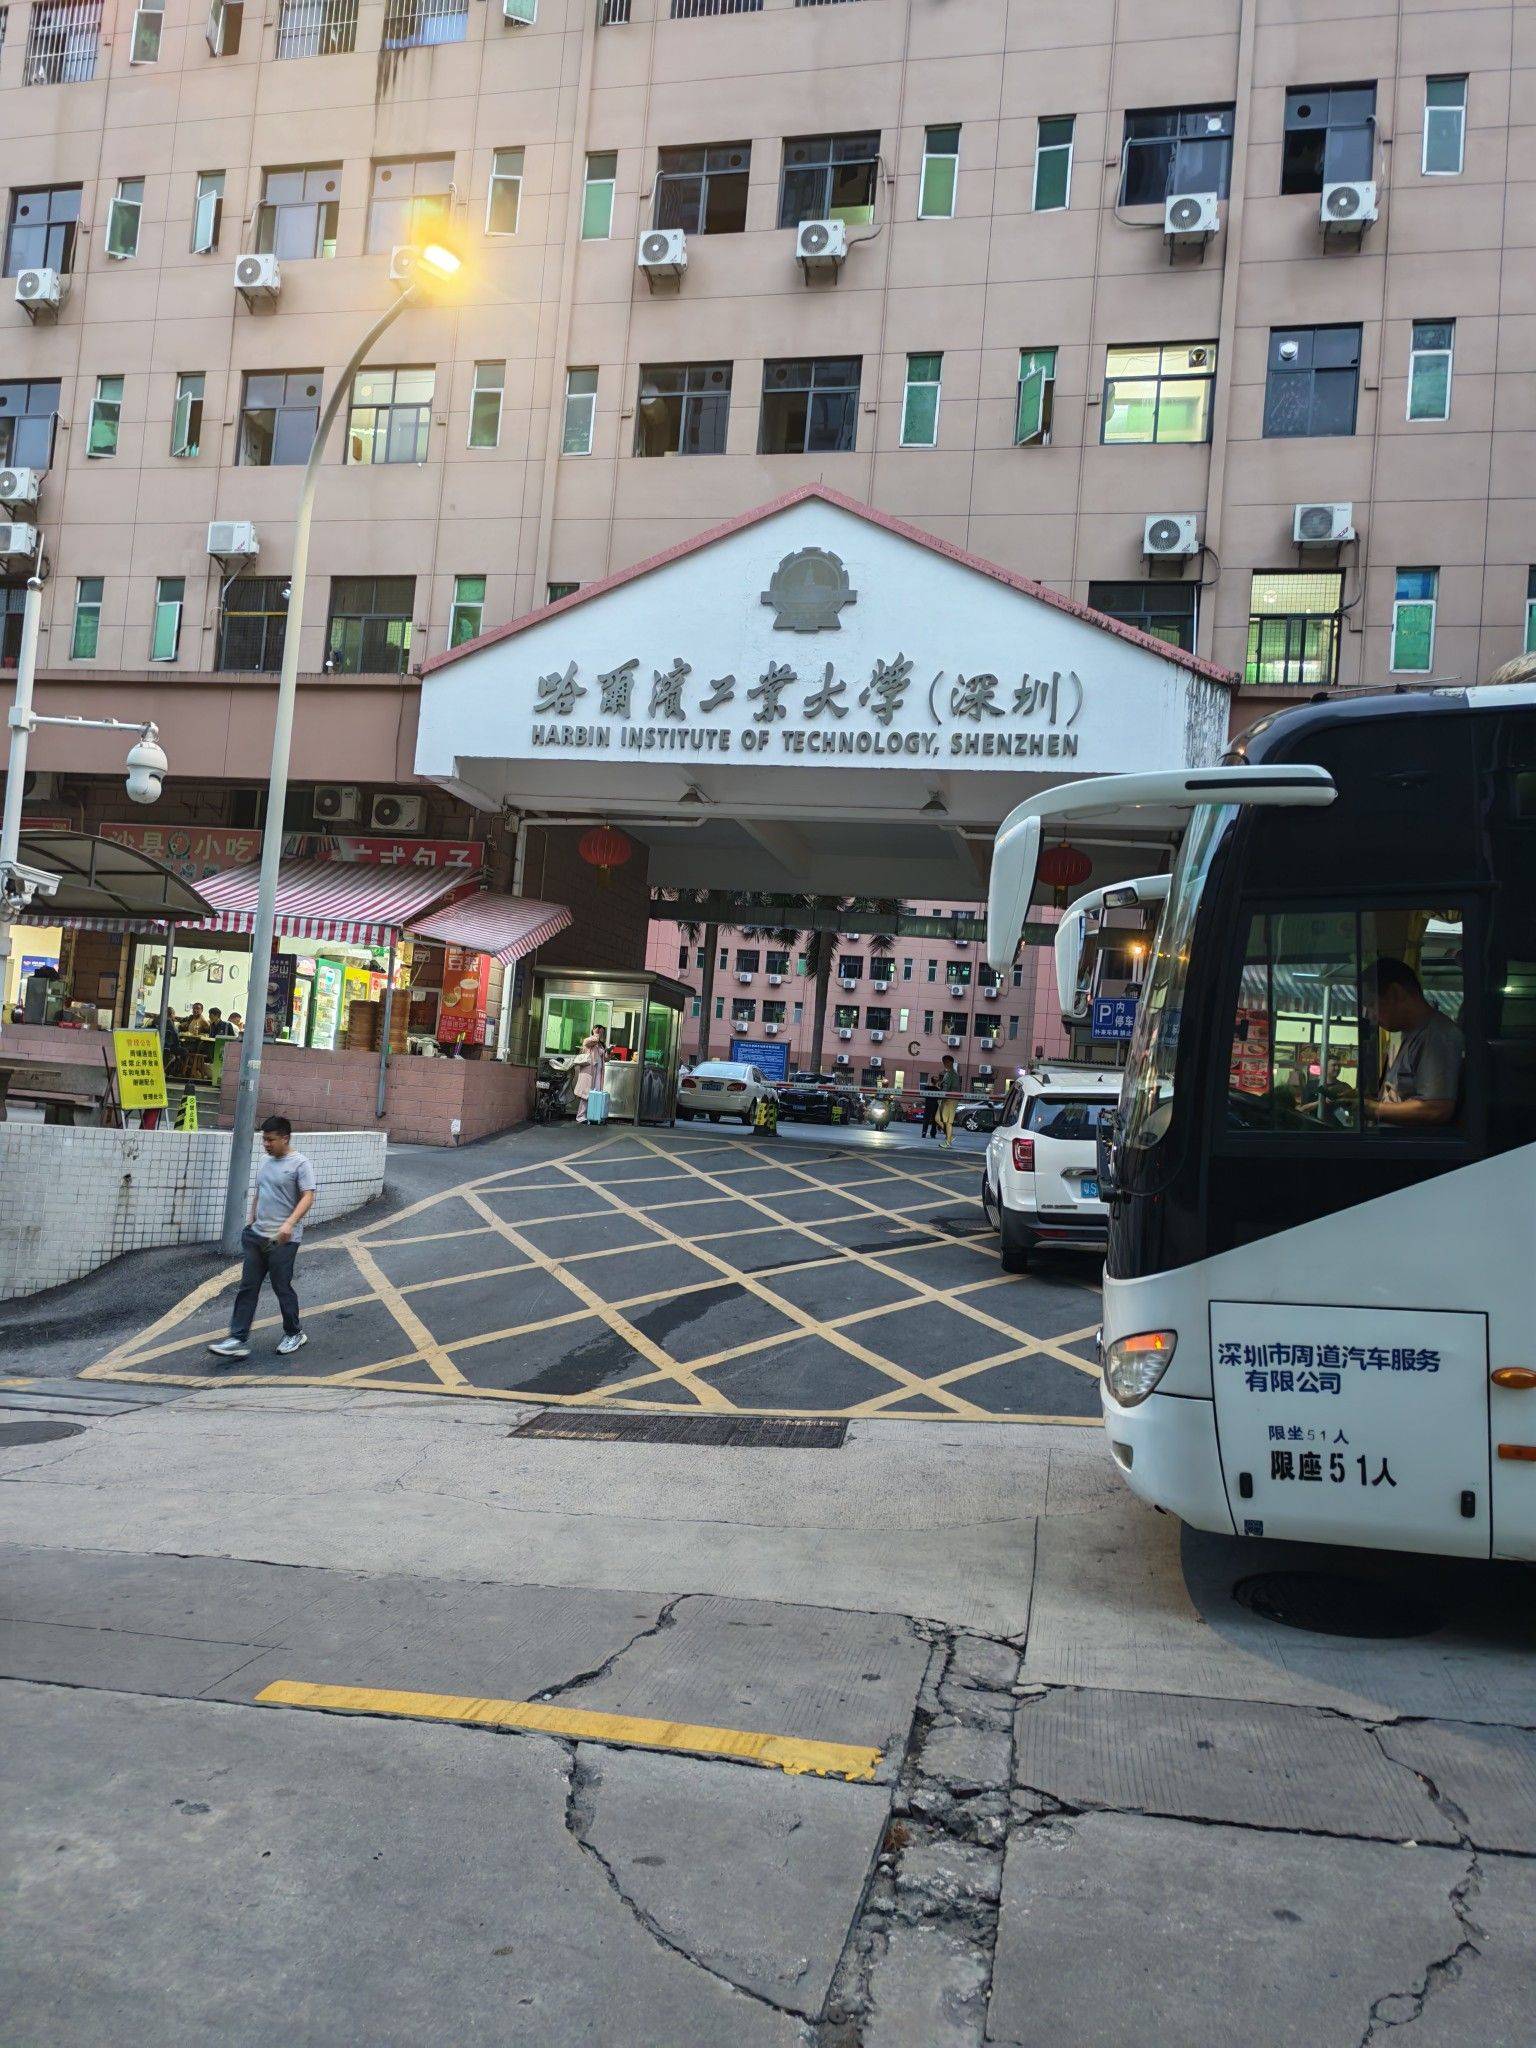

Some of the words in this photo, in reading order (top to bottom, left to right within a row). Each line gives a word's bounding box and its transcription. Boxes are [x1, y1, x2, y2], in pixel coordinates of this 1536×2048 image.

[532, 724, 611, 747] HARBIN
[621, 726, 731, 750] INSTITUTE
[740, 729, 770, 750] OF
[782, 730, 940, 758] TECHNOLOGY,
[950, 732, 1079, 757] SHENZHEN
[194, 833, 254, 863] 小吃
[1099, 1004, 1111, 1023] P
[908, 1041, 921, 1056] C
[1218, 1342, 1441, 1373] 深圳市周道汽车服务
[1245, 1369, 1341, 1394] 有限公司
[1268, 1425, 1350, 1445] 限坐51人
[1270, 1450, 1398, 1487] 限座51人
